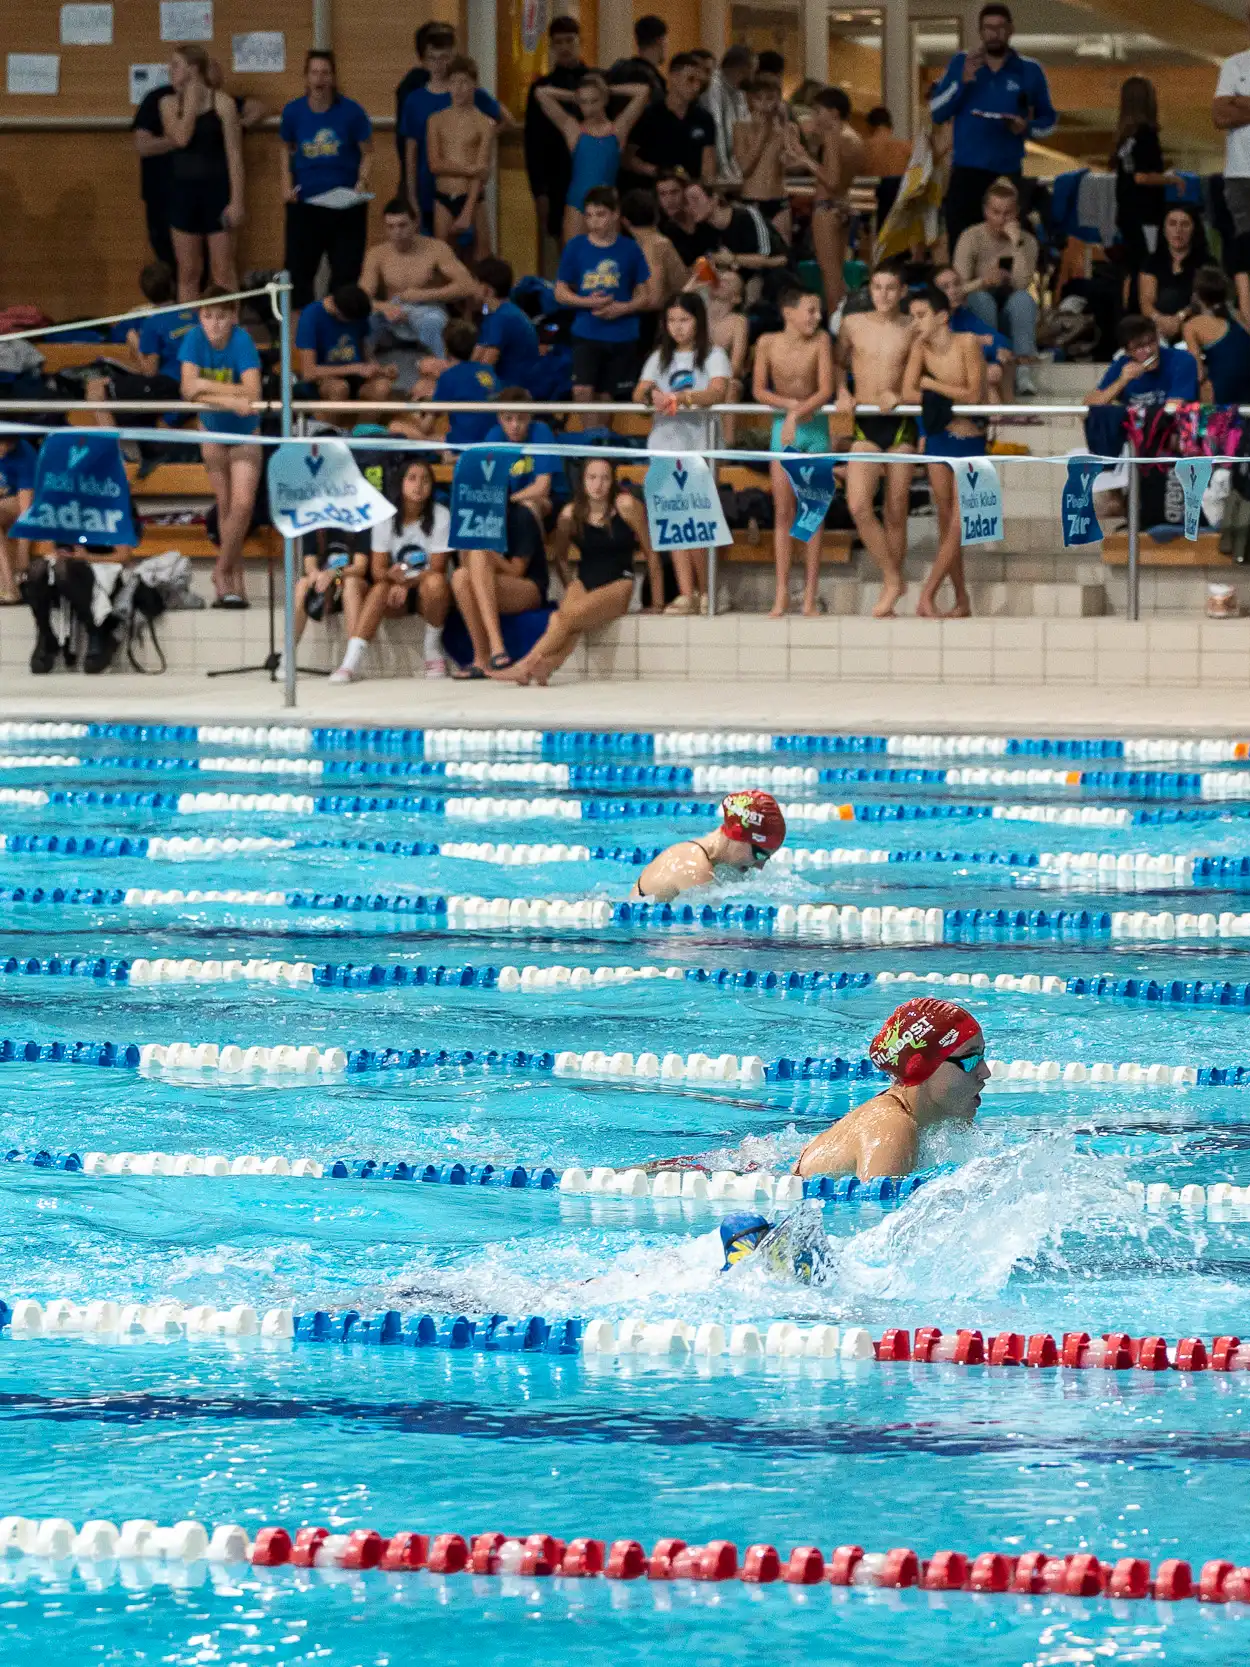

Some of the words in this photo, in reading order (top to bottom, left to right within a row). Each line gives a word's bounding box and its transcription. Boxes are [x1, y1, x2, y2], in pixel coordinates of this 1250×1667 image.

[656, 517, 717, 545] Zadar
[963, 514, 998, 539] Zadar
[872, 1016, 931, 1068] MLADOST
